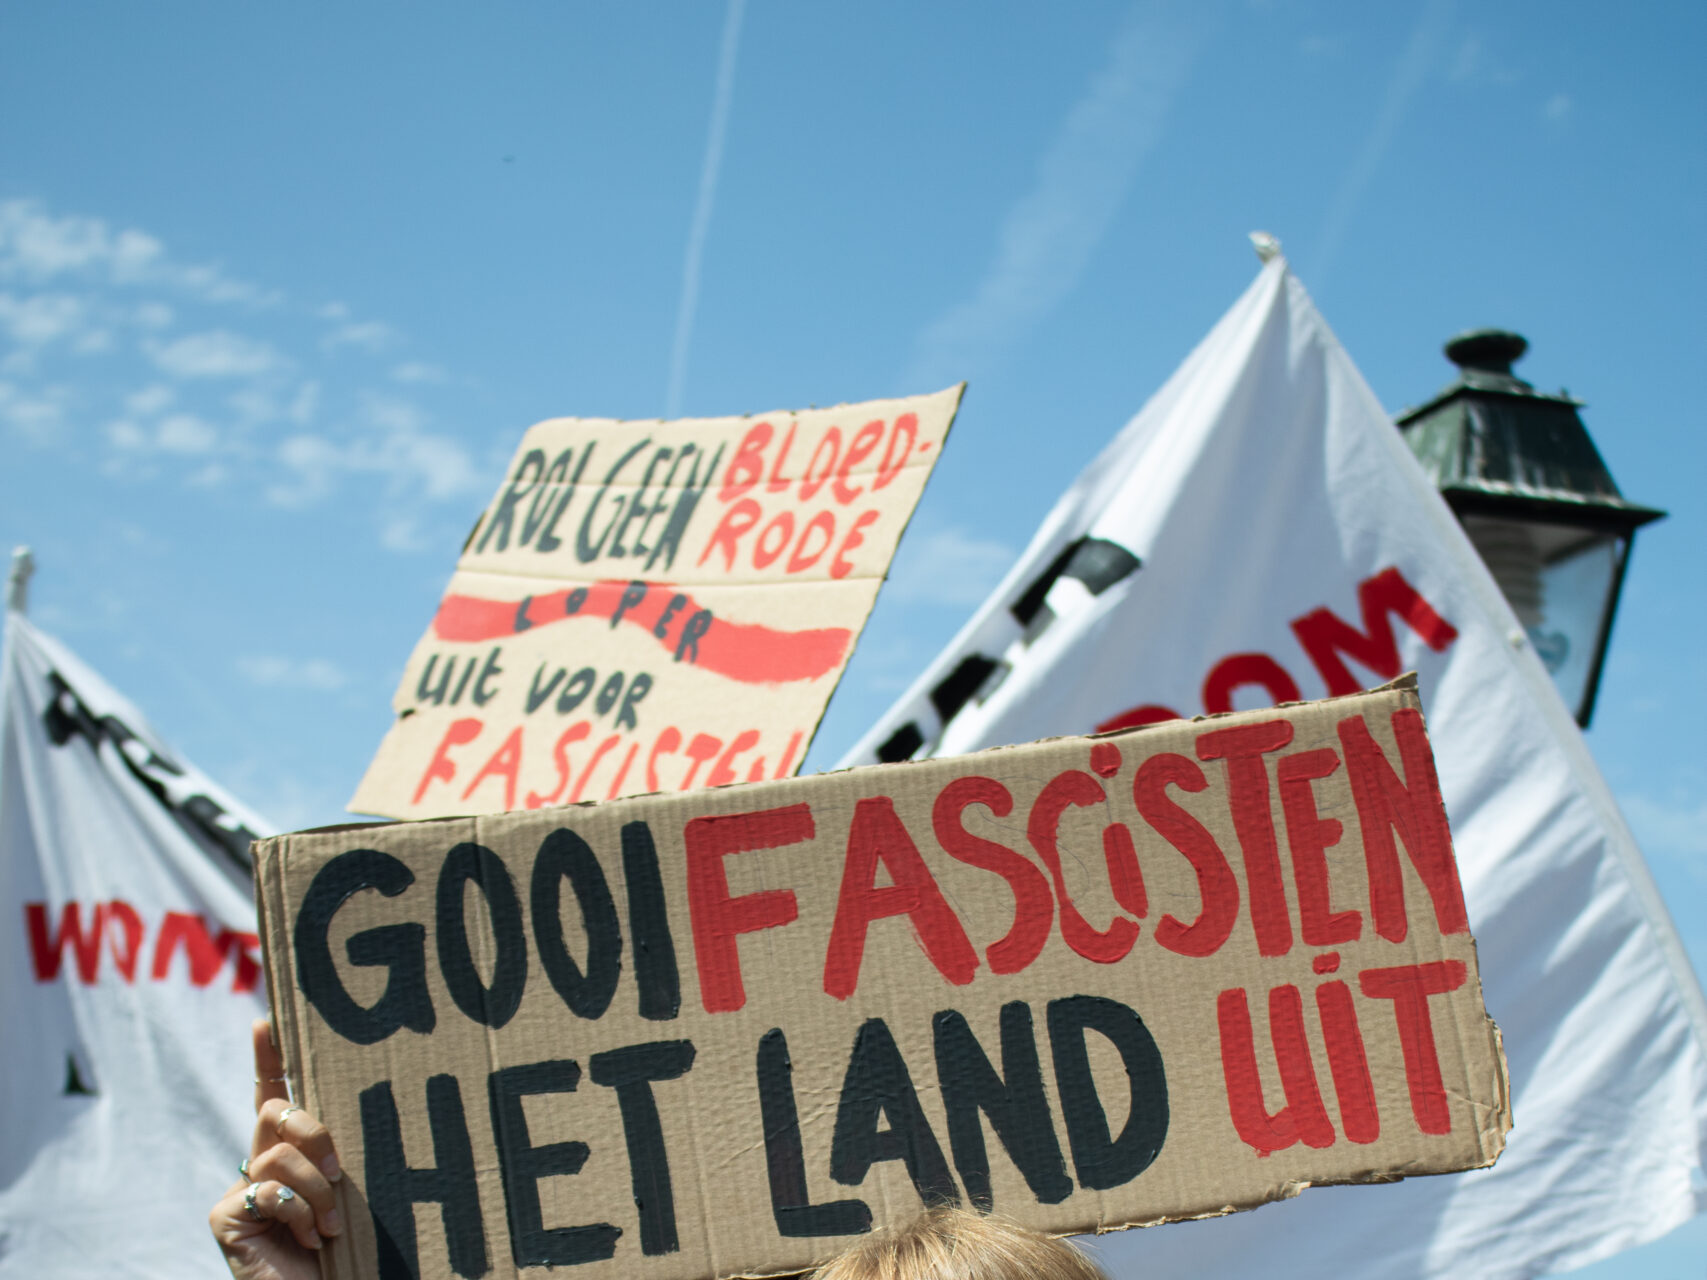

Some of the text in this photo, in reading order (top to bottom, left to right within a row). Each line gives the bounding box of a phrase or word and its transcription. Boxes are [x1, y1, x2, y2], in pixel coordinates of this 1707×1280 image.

[476, 439, 597, 554] ROL
[576, 434, 727, 572] GEEN
[697, 498, 880, 580] RODE
[513, 579, 713, 664] LOPER
[524, 660, 654, 732] VOOR
[294, 820, 682, 1045] GOOI
[757, 995, 1170, 1237] LAND
